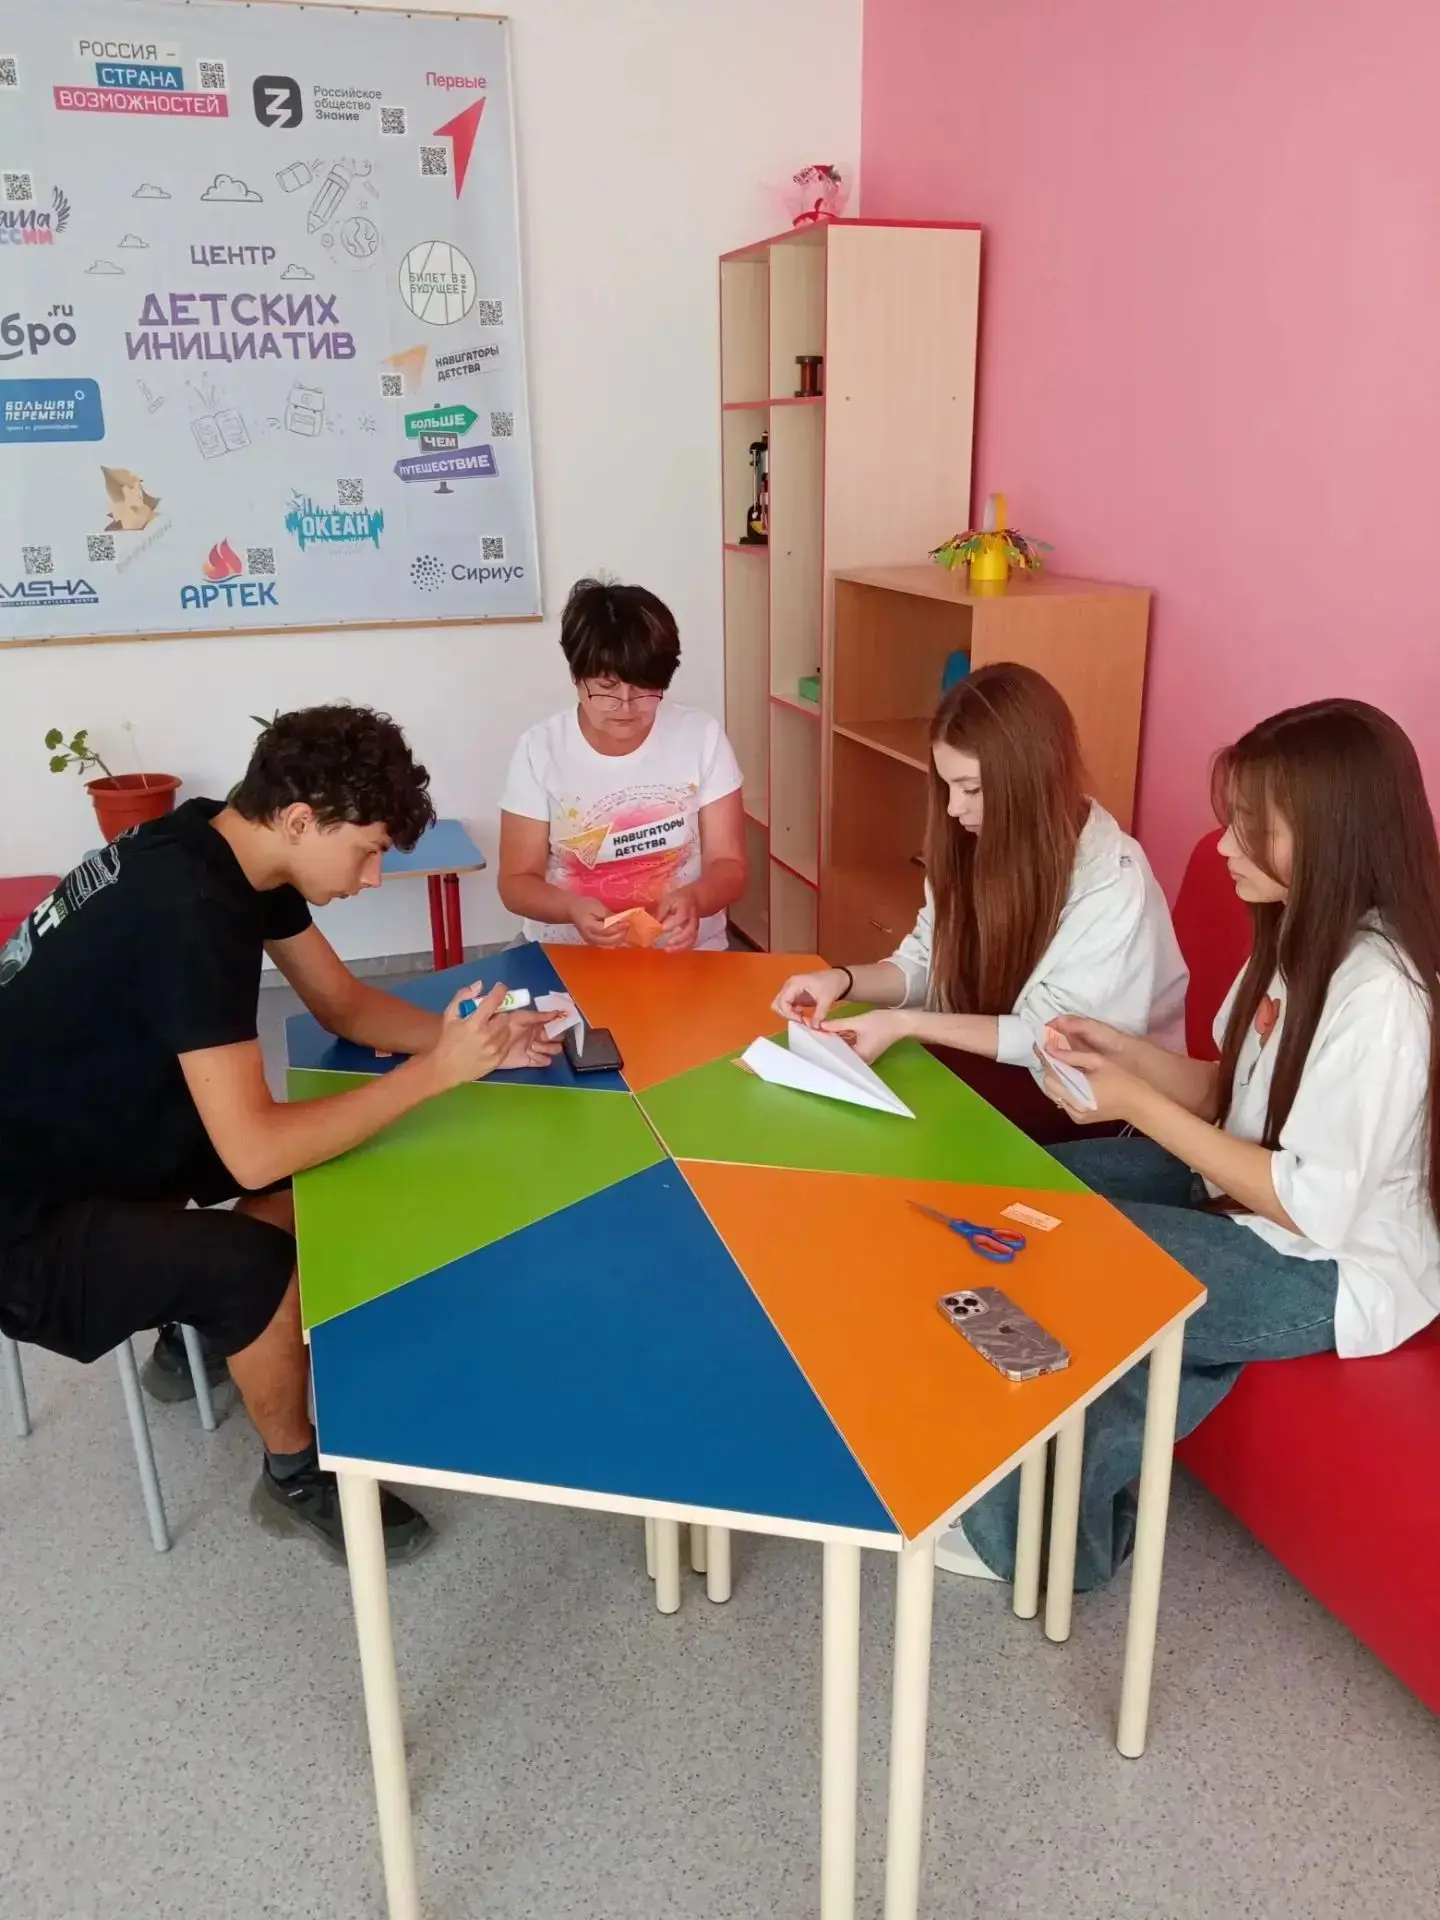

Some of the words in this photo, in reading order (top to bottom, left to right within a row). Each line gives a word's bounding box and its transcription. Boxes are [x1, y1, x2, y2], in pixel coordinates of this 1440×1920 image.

[79, 40, 157, 60] РОССИЯ
[101, 67, 178, 88] СТРАНА
[425, 71, 488, 91] Первые
[59, 90, 220, 114] ВОЗМОЖНОСТЕЙ
[313, 85, 382, 99] Российское
[314, 98, 371, 110] общество
[315, 109, 360, 121] Знание
[0, 229, 53, 245] ССИИ
[190, 245, 276, 266] ЦЕНТР
[409, 272, 446, 283] БИЛЕТ
[410, 283, 459, 294] БУДУЩЕЕ
[138, 292, 340, 326] ДЕТСКИХ
[0, 312, 76, 354] бро
[125, 332, 356, 363] ИНИЦИАТИВ
[435, 345, 499, 367] НАВИГАТОРЫ
[437, 363, 481, 382] ДЕТСТВА
[5, 400, 75, 411] БОЛЬШАЯ
[5, 410, 74, 421] ПЕРЕМЕНА
[411, 413, 466, 430] БОЛЬШЕ
[424, 435, 456, 447] ЧЕМ
[399, 454, 490, 477] ПУТЕШЕСТВИЕ
[302, 514, 369, 537] ОКЕАН
[451, 564, 525, 584] Сириус
[0, 579, 97, 599] МЕНА
[180, 582, 279, 609] АРТЕК
[613, 817, 685, 846] НАВИГАТОРЫ
[615, 837, 667, 858] ДЕТСТВА
